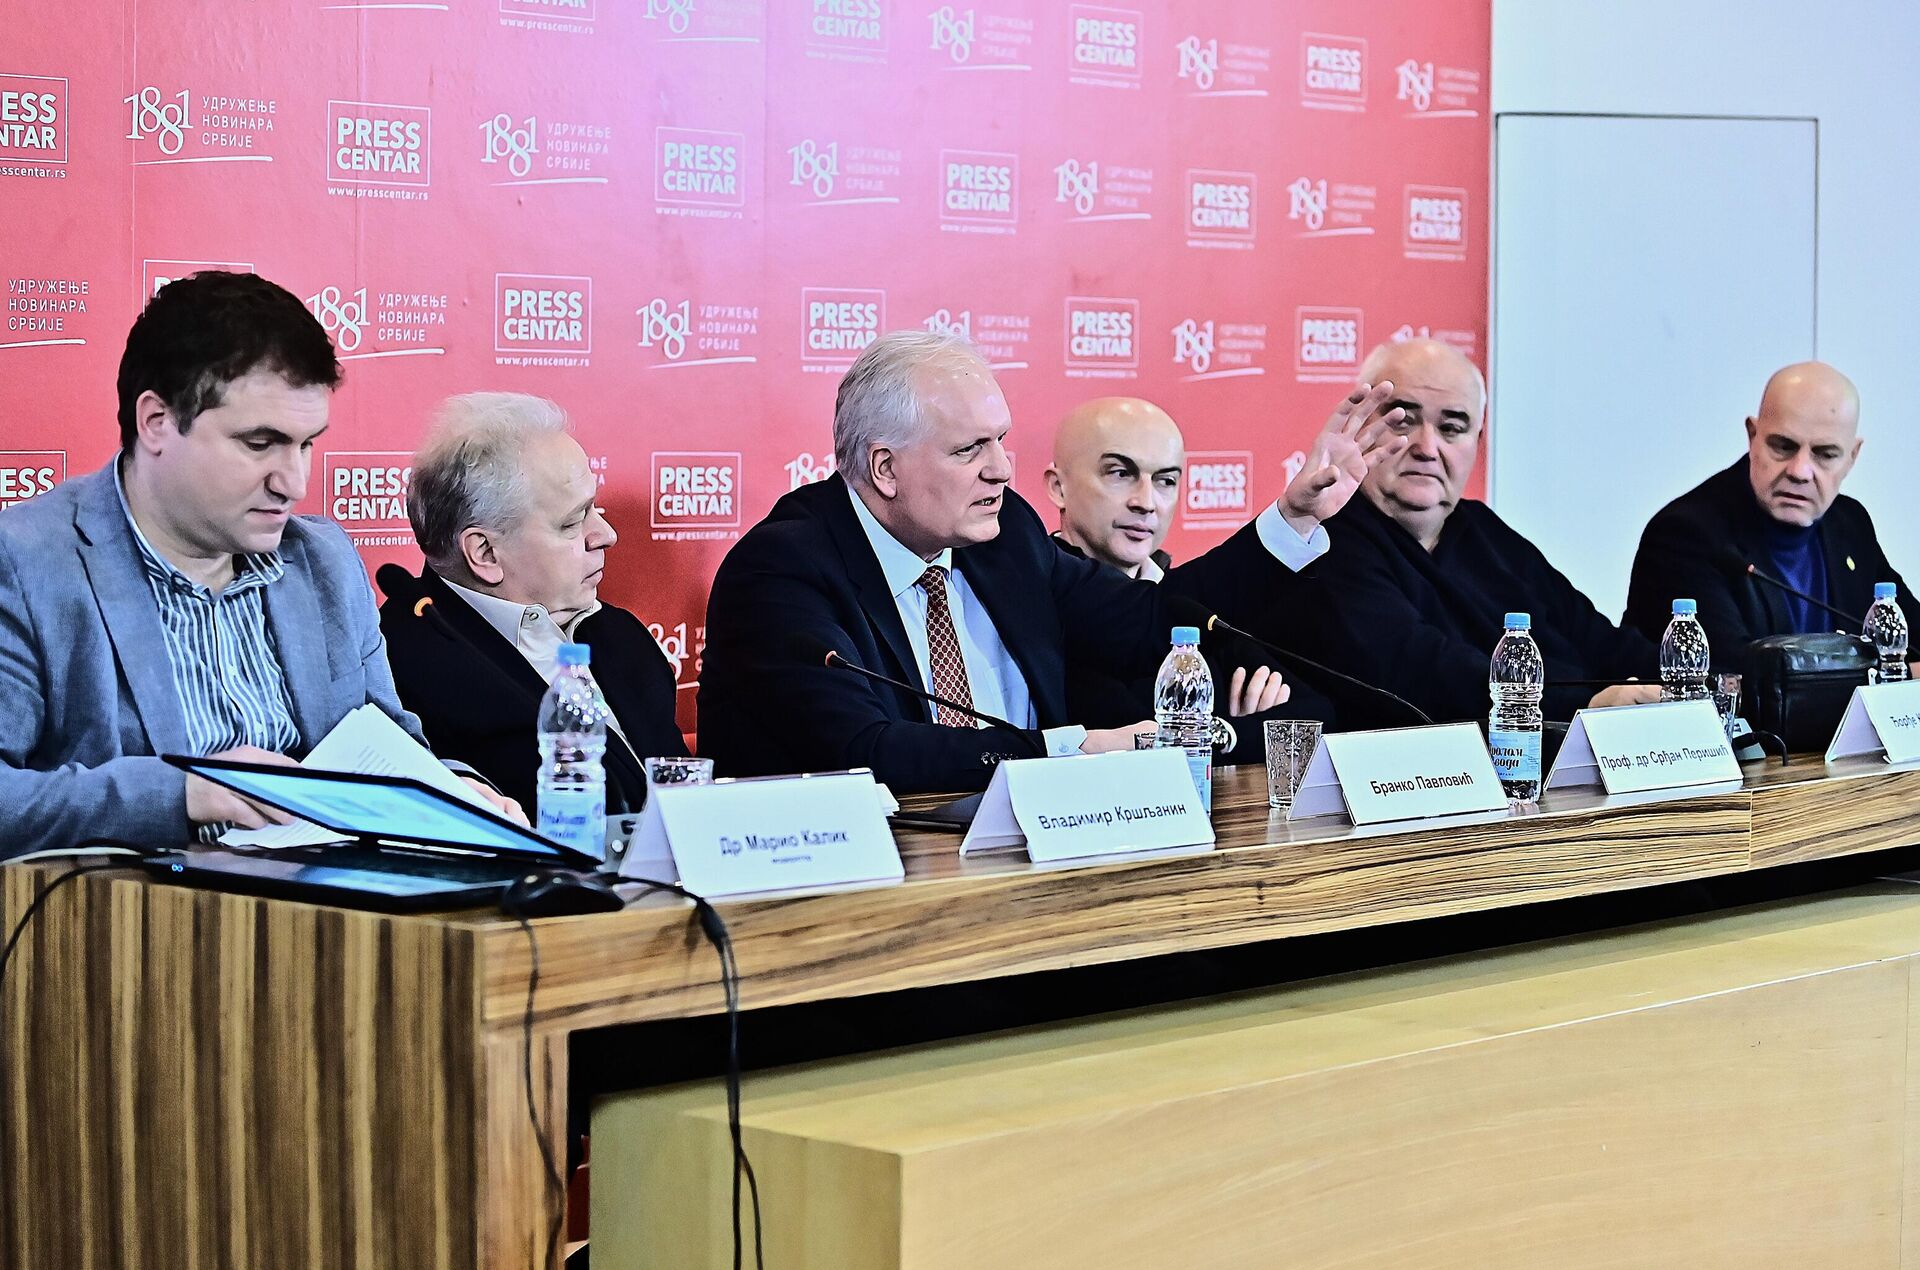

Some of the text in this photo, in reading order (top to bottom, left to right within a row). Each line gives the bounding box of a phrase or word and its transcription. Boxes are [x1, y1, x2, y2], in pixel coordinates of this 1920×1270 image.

[499, 17, 594, 34] www.presscentar.rs
[812, 16, 881, 40] CENTAR
[1075, 18, 1136, 47] PRESS
[1074, 43, 1136, 67] CENTAR
[1306, 45, 1361, 72] PRESS
[1, 91, 57, 124] ESS
[202, 96, 276, 114] УДРУЖЕЊЕ
[123, 86, 194, 155] 1881
[202, 115, 274, 132] НОВИНАРА
[547, 122, 612, 140] УДРУЖЕЊЕ
[202, 132, 253, 148] СРБИЈЕ
[337, 117, 421, 150] PRESS
[478, 113, 540, 177] 1881
[546, 140, 609, 155] НОВИНАРА
[664, 142, 737, 173] PRESS
[0, 166, 66, 179] sscentar.rs
[336, 147, 421, 174] CENTAR
[546, 155, 591, 171] СРБИЈЕ
[787, 139, 840, 198] 1881
[663, 169, 736, 194] CENTAR
[947, 163, 1011, 192] PRESS
[327, 186, 429, 201] www.presscentar.rs
[946, 189, 1010, 213] CENTAR
[1193, 182, 1249, 208] PRESS
[1192, 207, 1249, 228] CENTAR
[1410, 197, 1461, 222] PRESS
[9, 279, 89, 295] УДРУЖЕЊЕ
[9, 298, 88, 314] НОВИНАРА
[378, 292, 448, 308] УДРУЖЕЊЕ
[504, 289, 583, 319] PRESS
[8, 316, 64, 332] СРБИЈЕ
[378, 310, 446, 325] НОВИНАРА
[809, 301, 878, 329] PRESS
[1071, 310, 1132, 337] PRESS
[378, 327, 426, 343] СРБИЈЕ
[503, 317, 583, 342] CENTAR
[636, 298, 693, 360] 1881
[1302, 319, 1357, 343] PRESS
[699, 336, 740, 352] СРБИЈЕ
[1071, 336, 1132, 357] CENTAR
[495, 355, 590, 368] www.presscentar.rs
[0, 467, 55, 499] ESS
[660, 466, 733, 494] PRESS
[1187, 463, 1246, 488] PRESS
[659, 494, 733, 517] CENTAR
[353, 536, 415, 547] presscentar.
[1600, 744, 1730, 771] Проф. др Срђан Перишић
[1370, 772, 1474, 797] Бранко Павловић
[1038, 803, 1187, 830] Владимир Кршљанин
